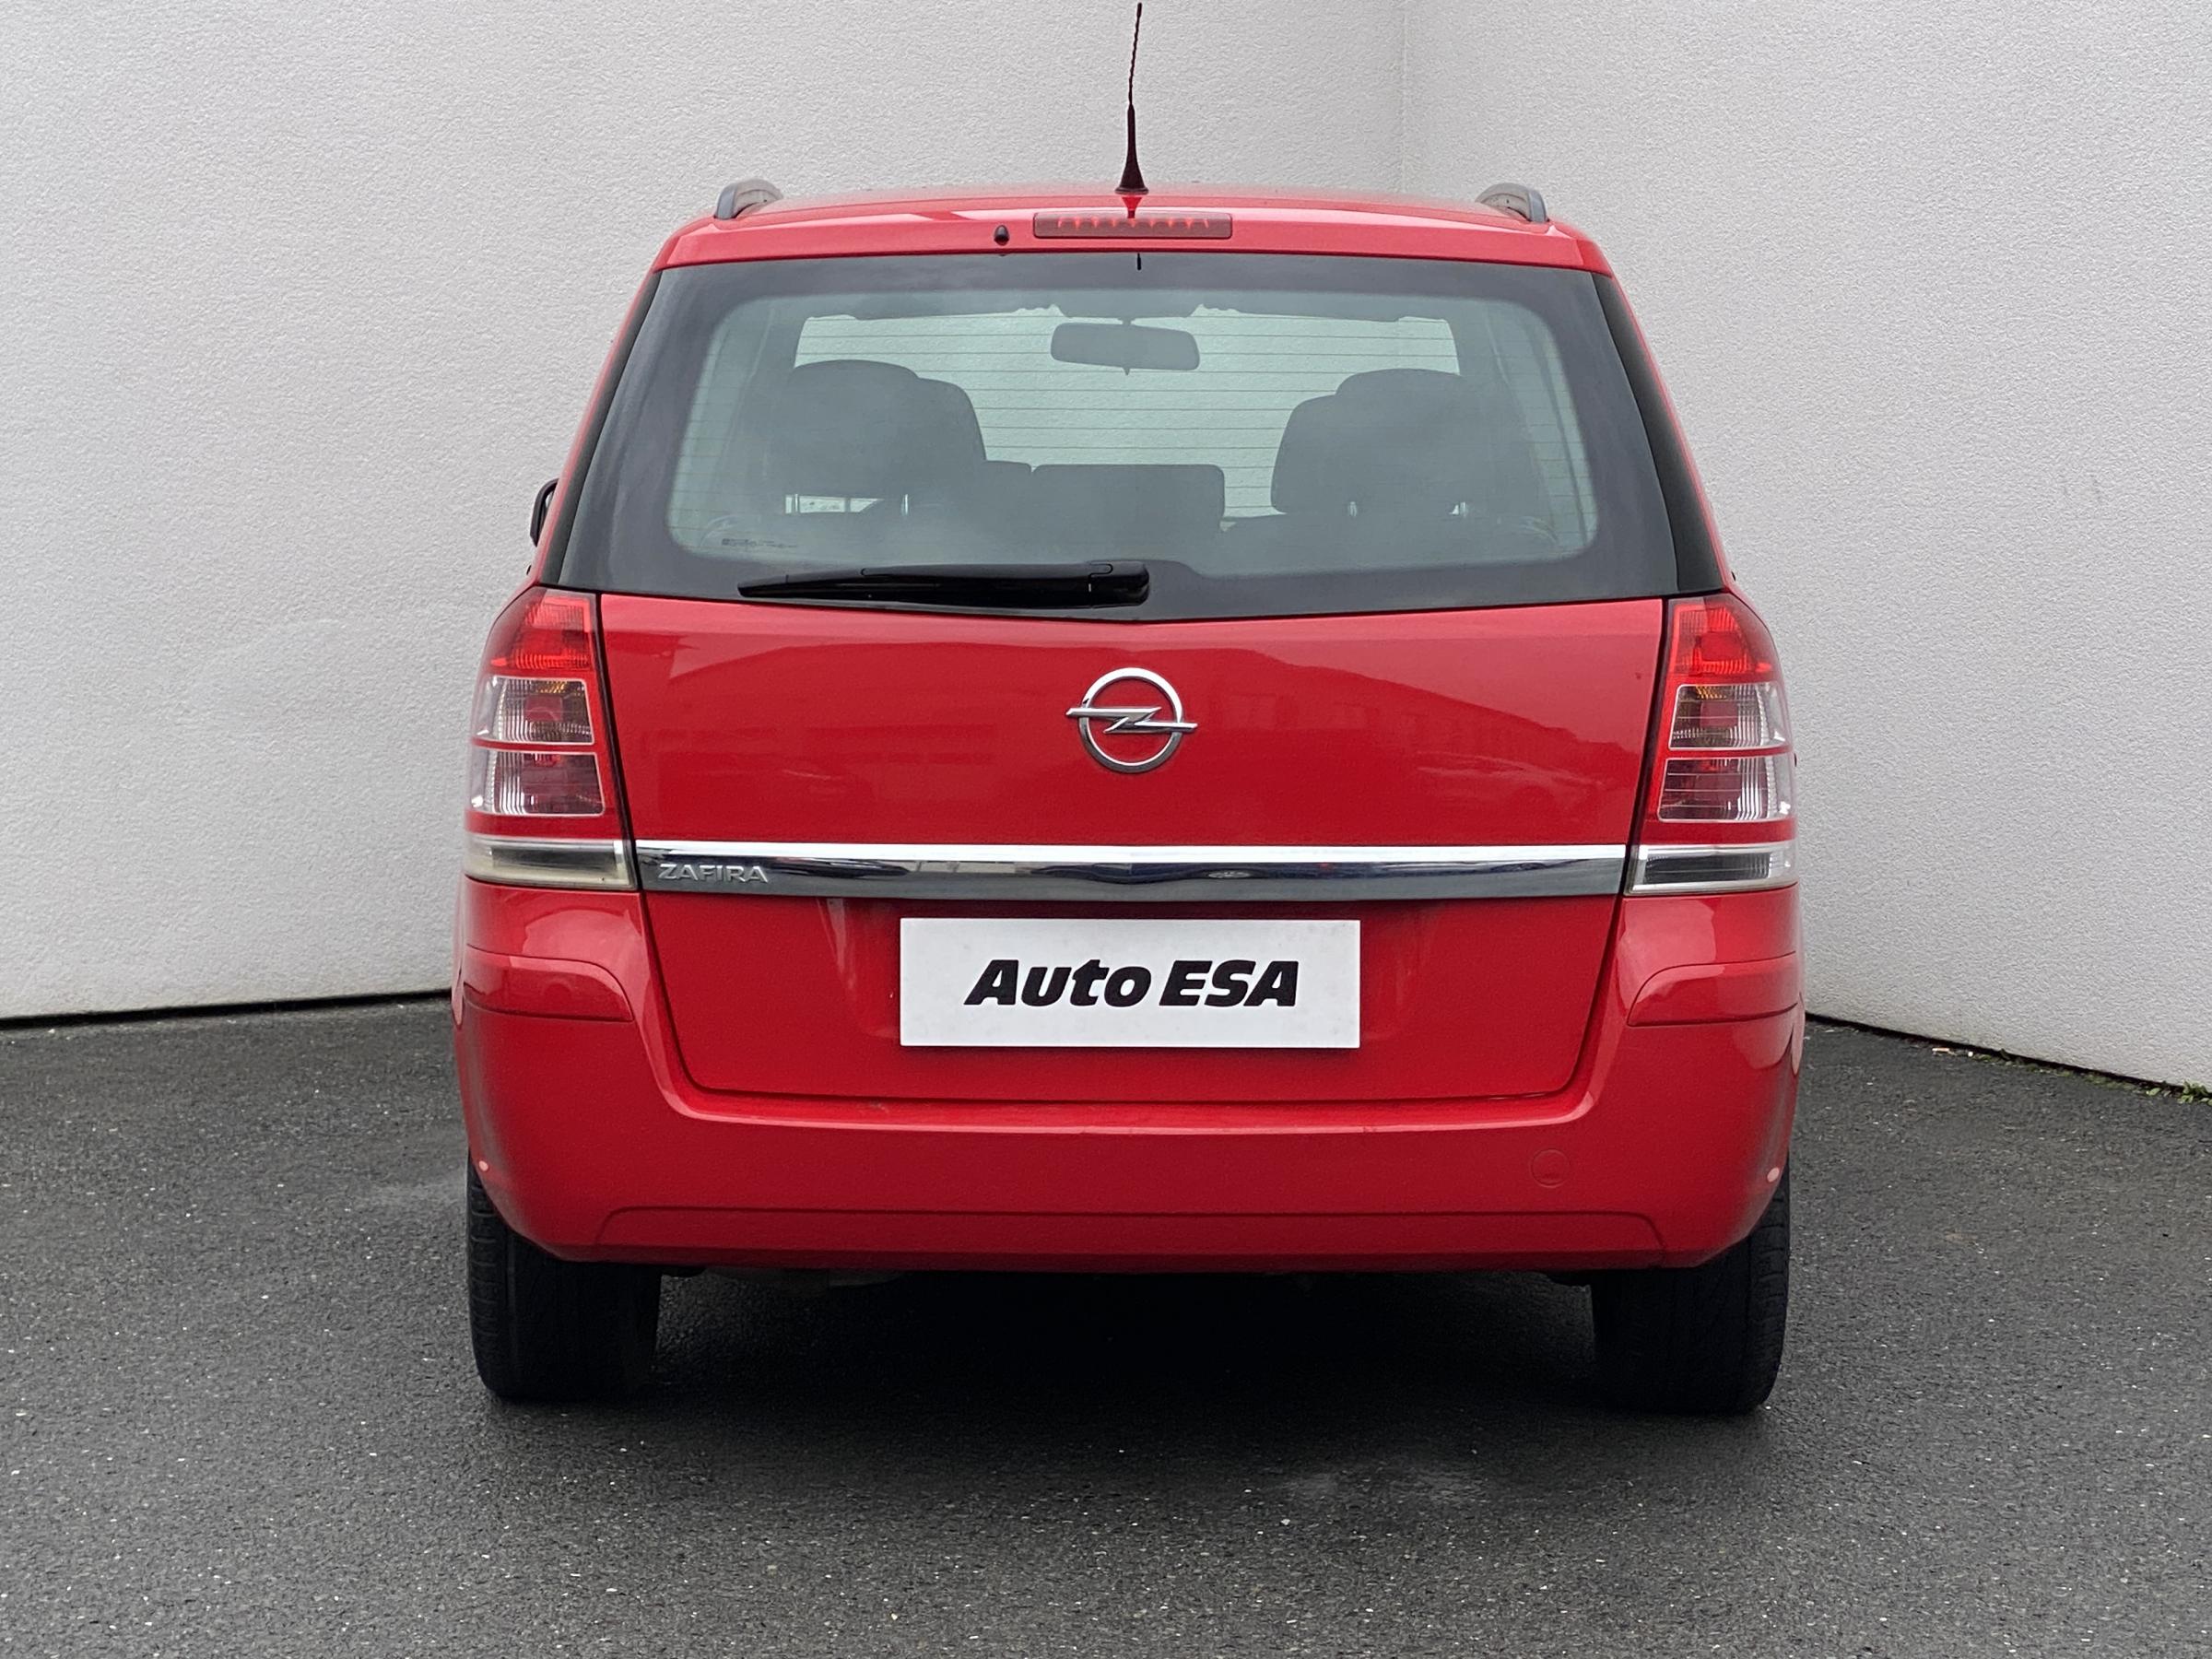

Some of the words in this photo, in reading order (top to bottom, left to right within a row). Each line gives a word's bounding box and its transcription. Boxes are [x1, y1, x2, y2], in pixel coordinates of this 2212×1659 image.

[658, 863, 769, 883] ZAFIRA
[963, 959, 1151, 1007] Auto
[1159, 960, 1299, 1007] ESA
